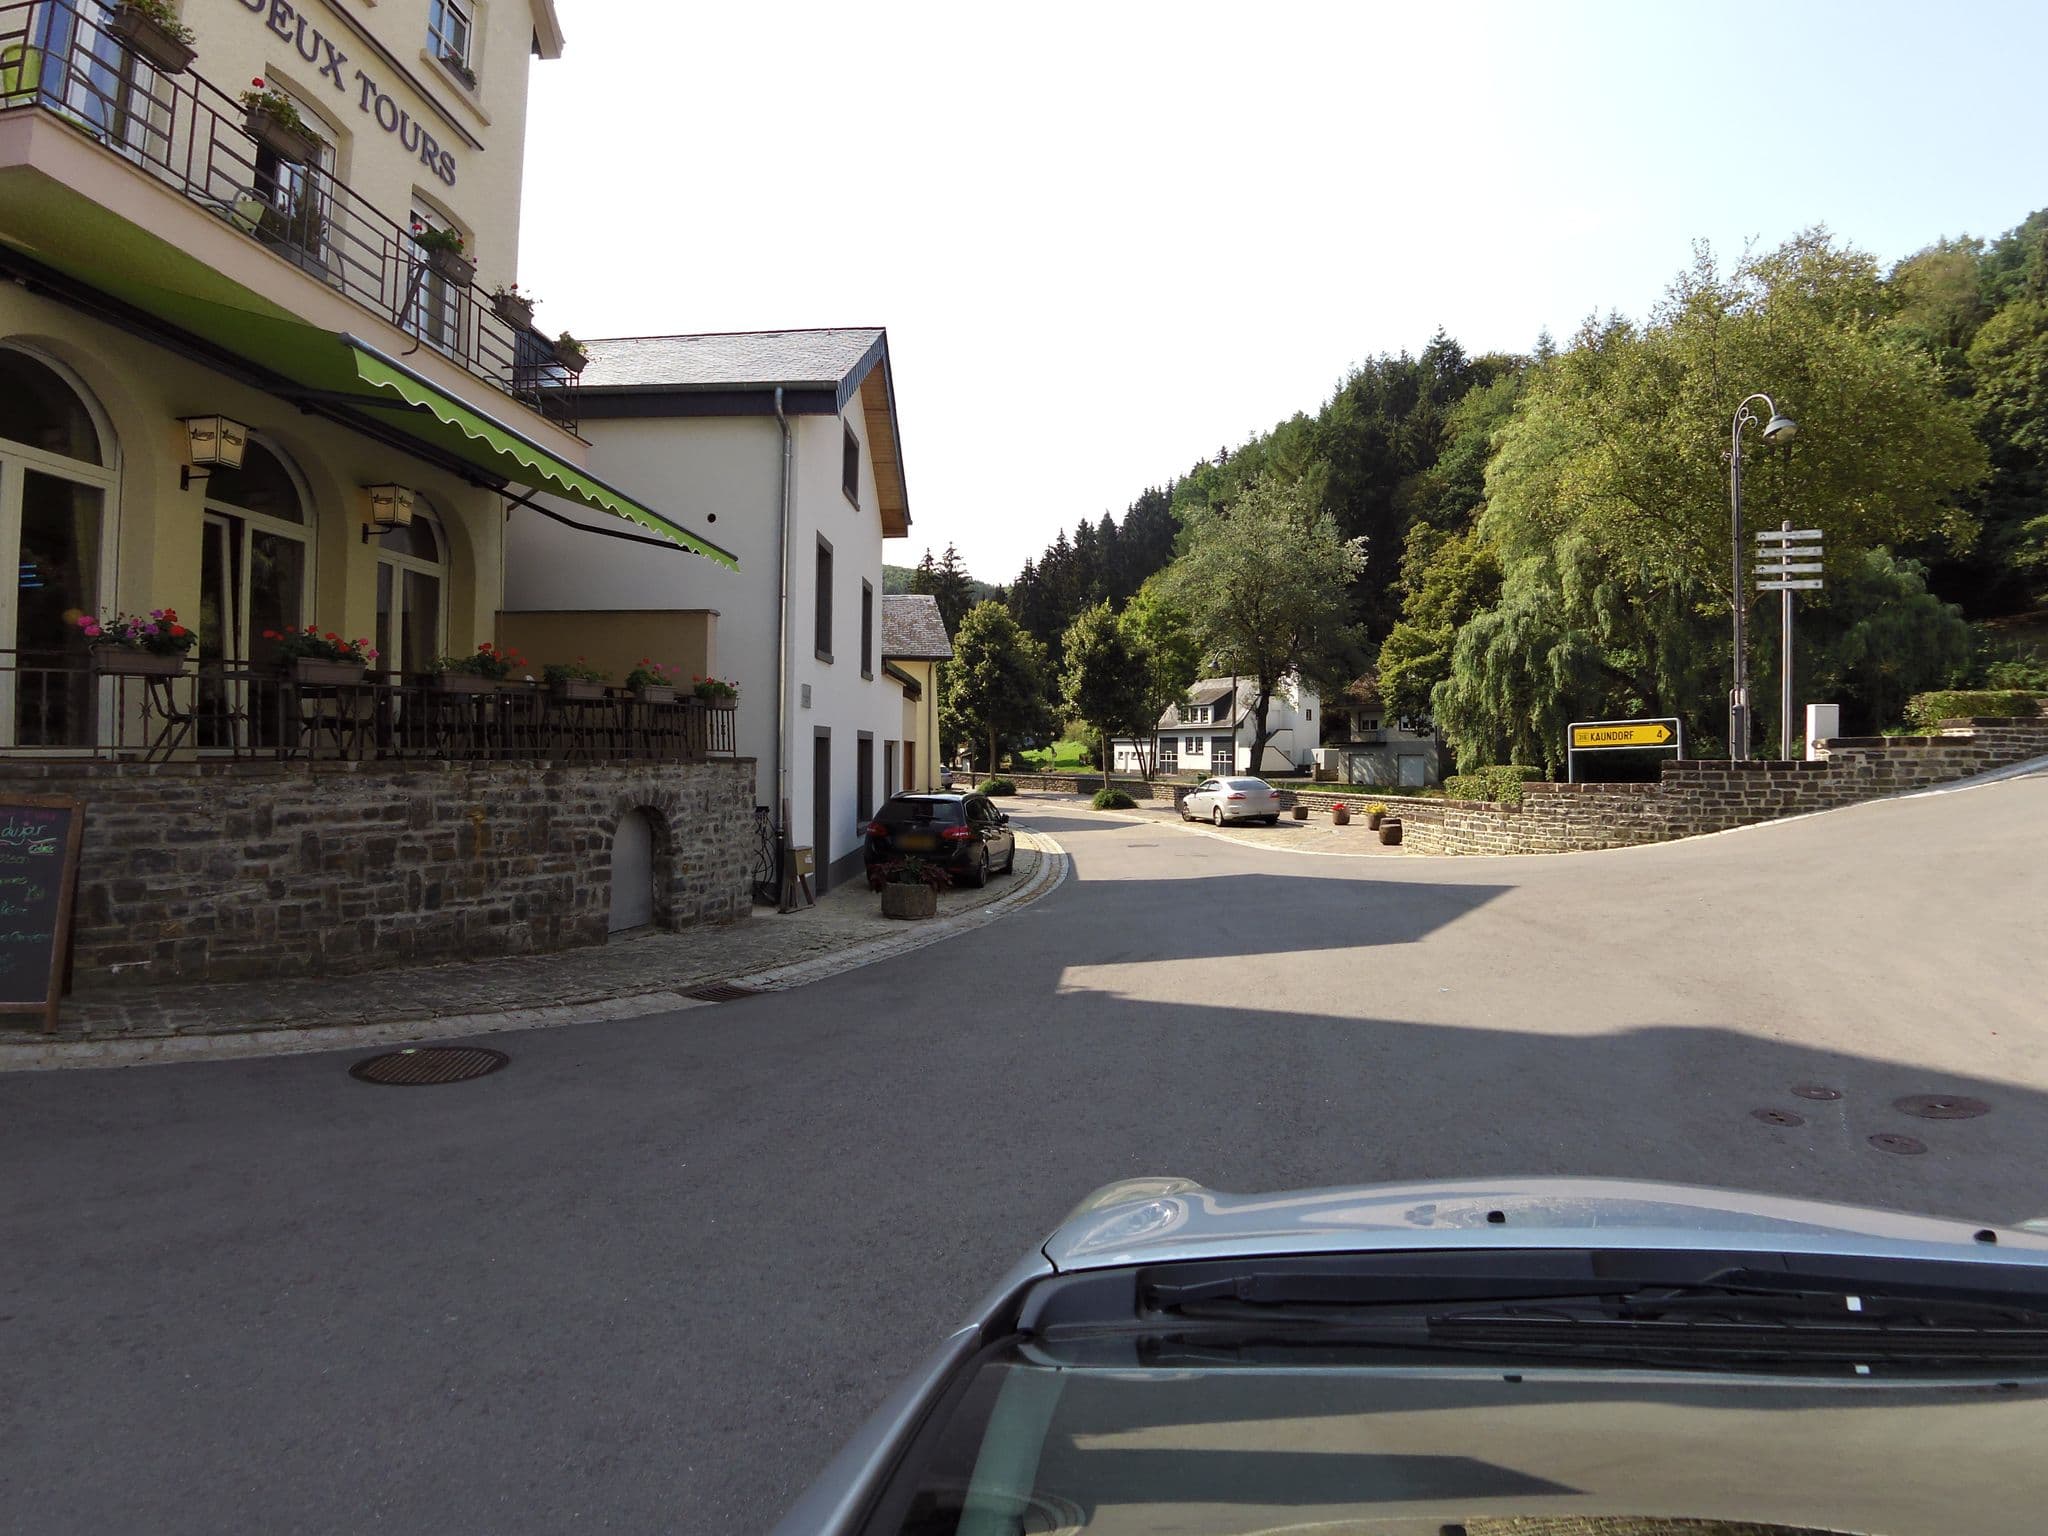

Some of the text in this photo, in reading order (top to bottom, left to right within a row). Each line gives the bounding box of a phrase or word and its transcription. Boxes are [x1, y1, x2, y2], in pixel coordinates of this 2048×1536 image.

[355, 69, 457, 187] TOURS
[1590, 731, 1635, 741] KAUNDORF
[1656, 730, 1662, 738] 4
